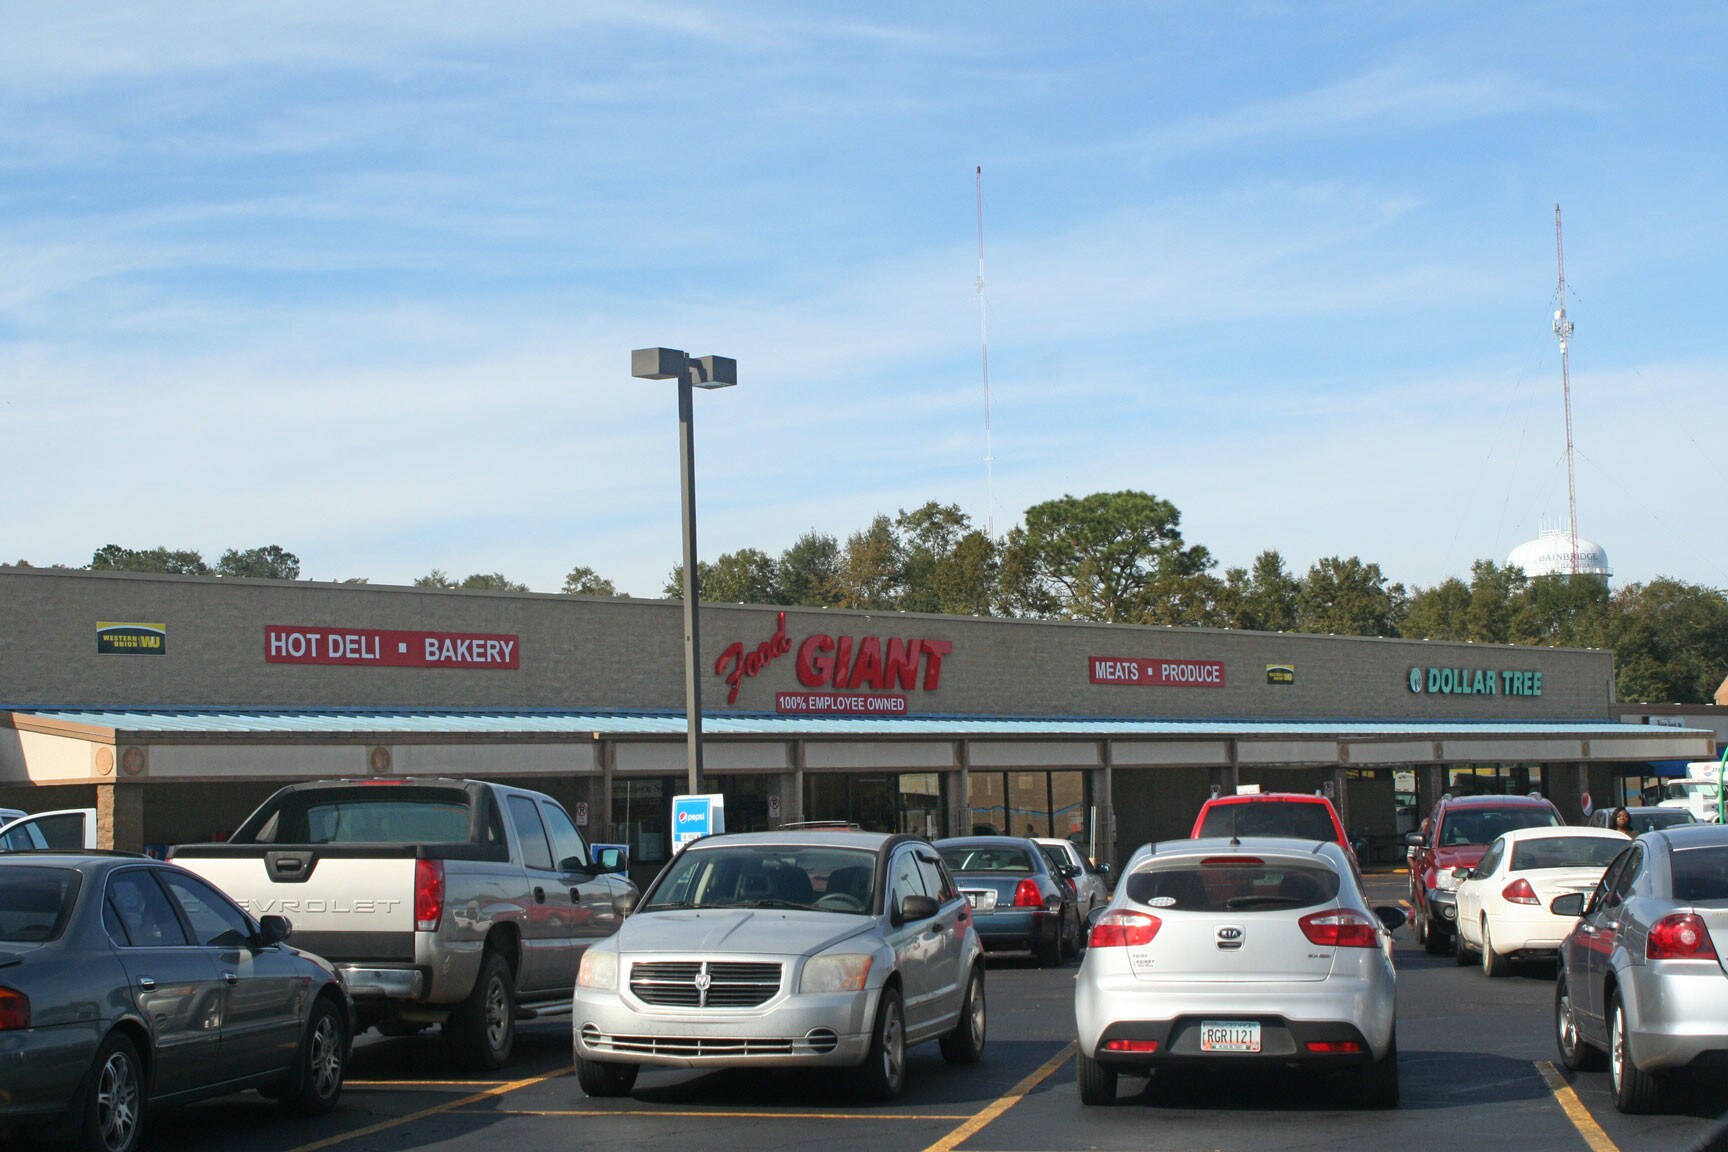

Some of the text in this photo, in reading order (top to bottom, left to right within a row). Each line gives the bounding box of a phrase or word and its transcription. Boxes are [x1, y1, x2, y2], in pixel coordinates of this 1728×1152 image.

[102, 634, 161, 648] WESTERN WU
[270, 632, 514, 663] HOT DELI BAKERY
[796, 634, 953, 691] GIANT
[1095, 661, 1221, 683] MEATS PRODUCE
[1427, 667, 1542, 696] DOLLAR TREE
[779, 696, 905, 711] 100% EMPLOYEE OWNED
[687, 812, 705, 822] pepsi
[1207, 1028, 1253, 1044] RGR1121
